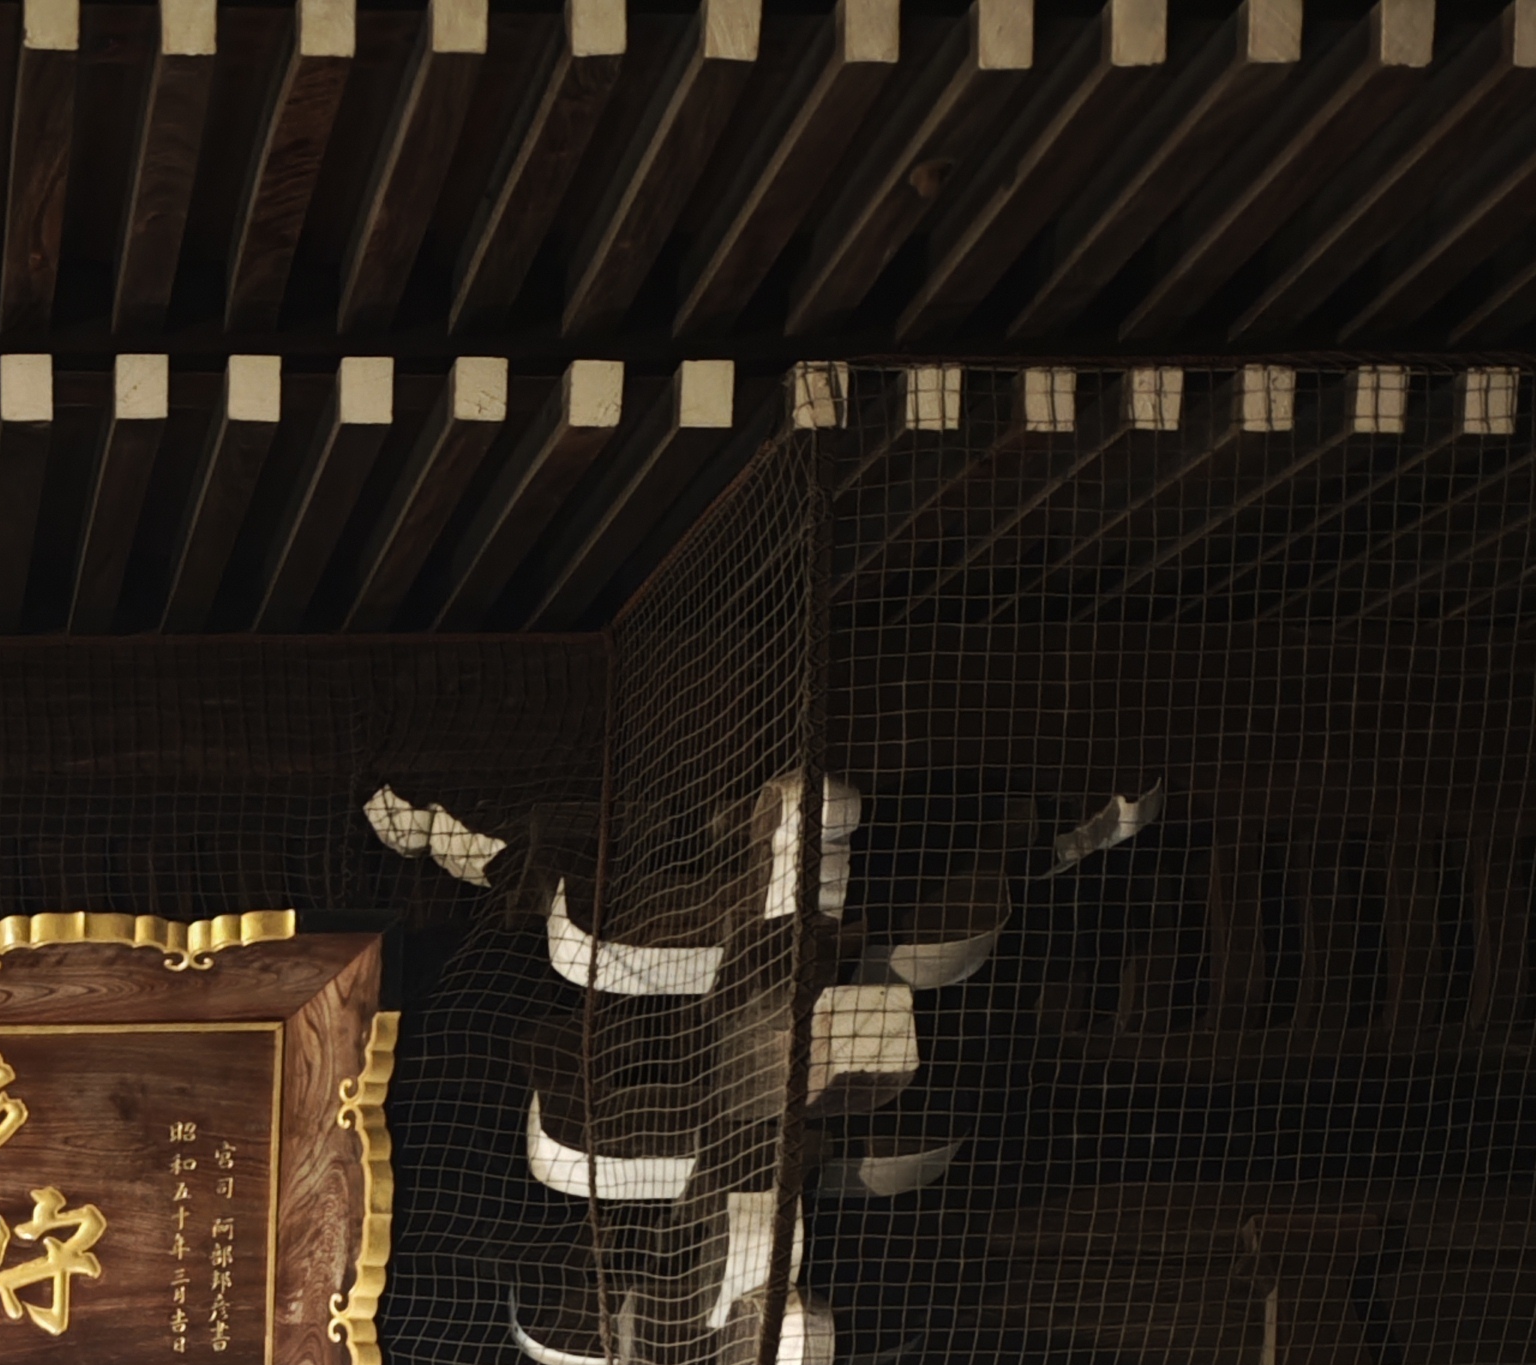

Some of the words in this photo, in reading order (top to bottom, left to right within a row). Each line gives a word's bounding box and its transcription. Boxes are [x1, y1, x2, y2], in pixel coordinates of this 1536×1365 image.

[169, 1121, 197, 1353] 昭和五十年三月吉日
[215, 1141, 236, 1199] 宮司
